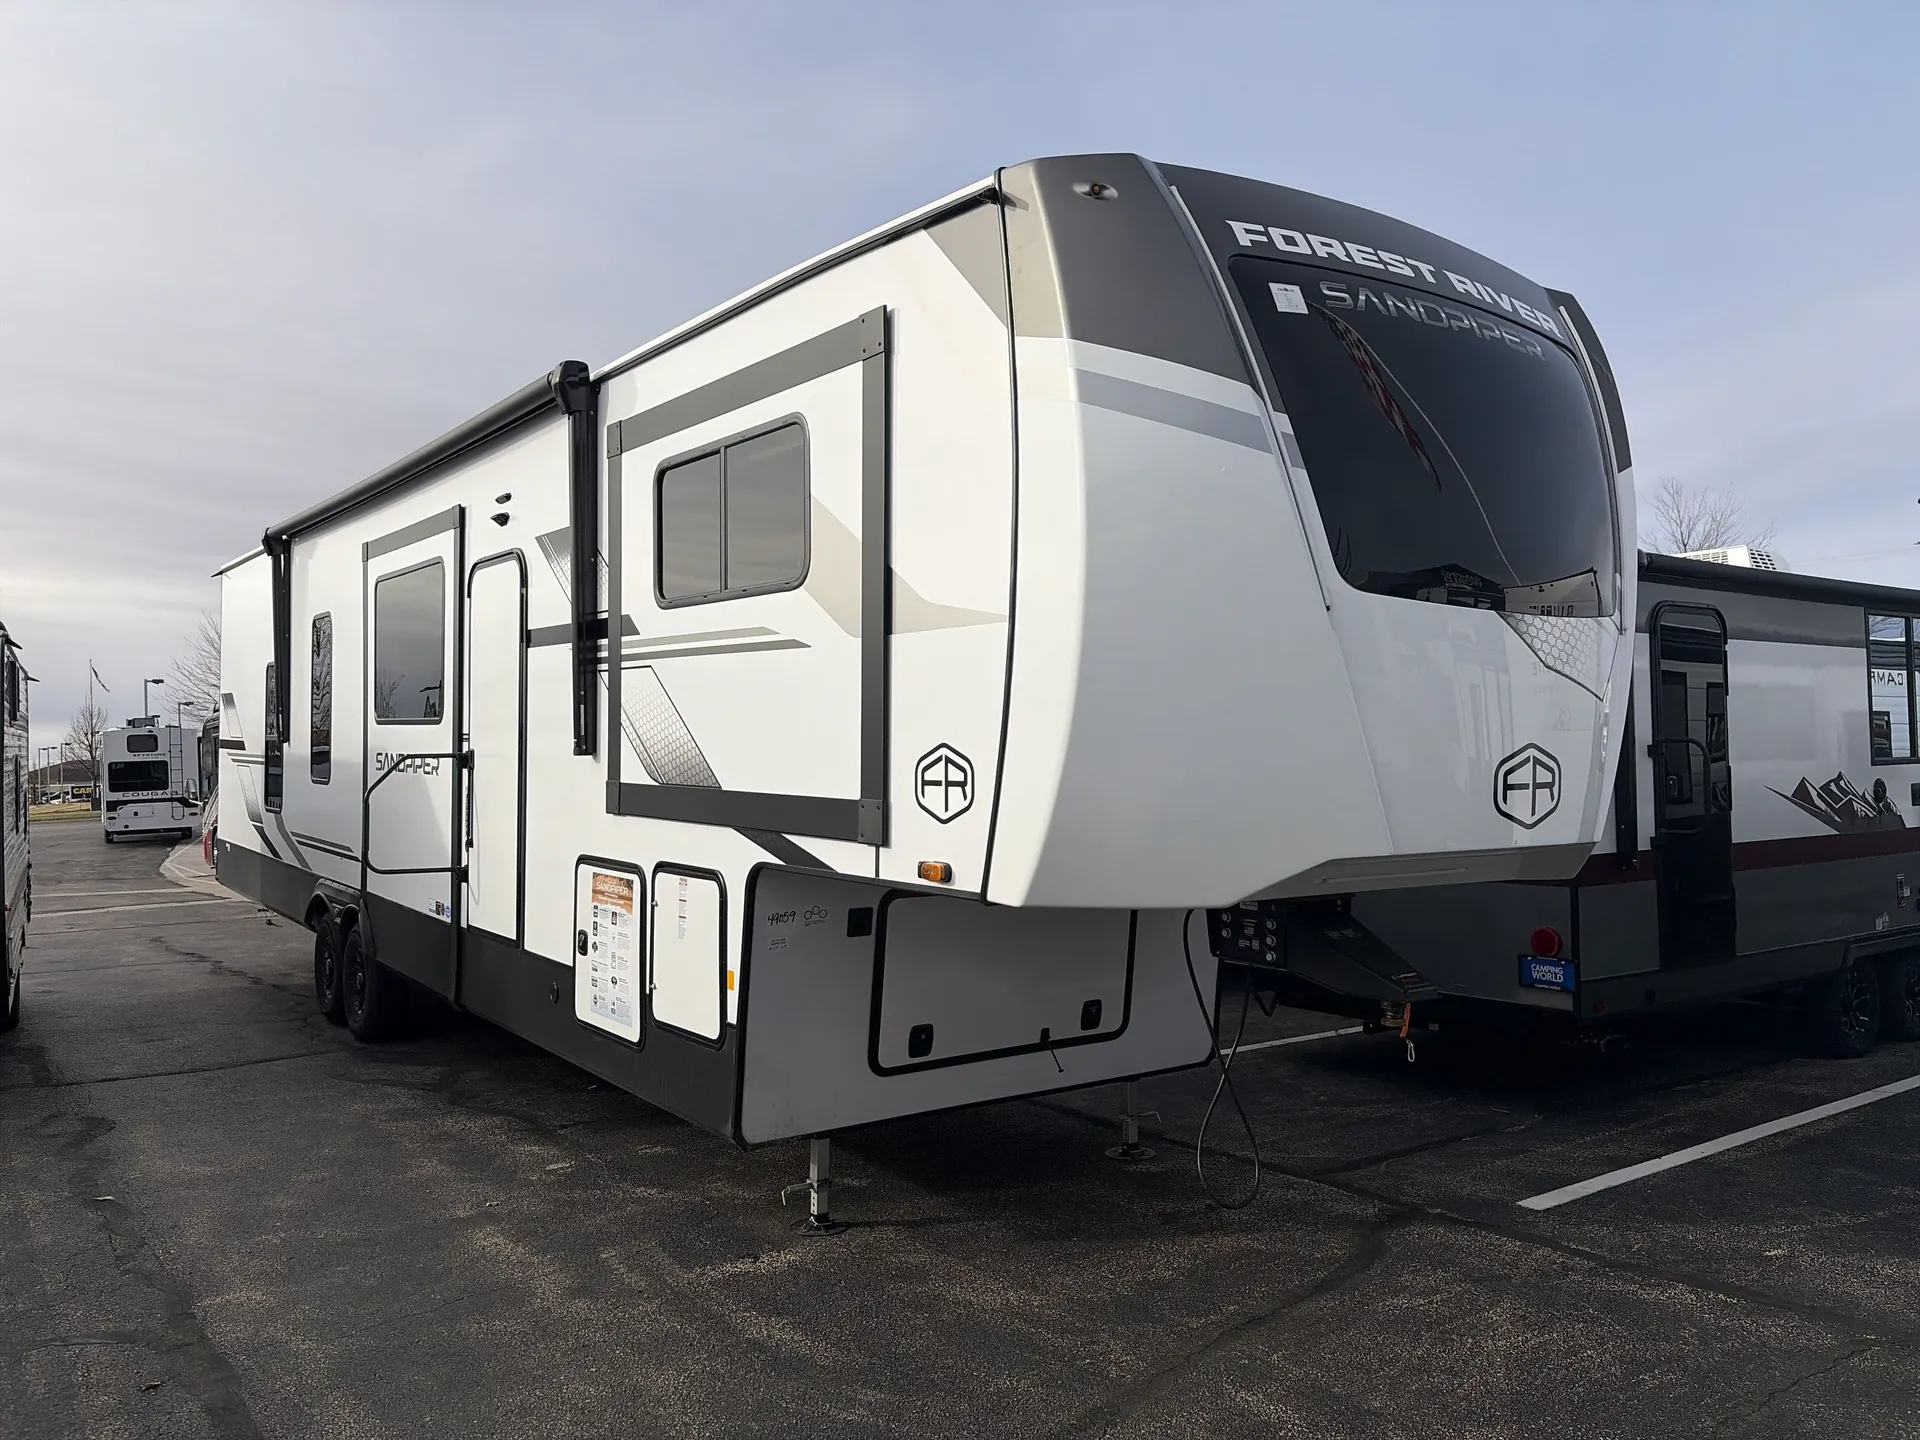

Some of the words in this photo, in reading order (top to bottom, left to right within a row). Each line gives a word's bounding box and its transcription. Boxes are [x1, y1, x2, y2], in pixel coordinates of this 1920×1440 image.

[1225, 219, 1437, 284] FOREST
[1442, 269, 1564, 340] RIVER
[1319, 280, 1548, 363] SANDPIPER
[767, 910, 797, 927] 49059
[1530, 963, 1564, 975] CAMPING
[1531, 970, 1564, 983] WORLD
